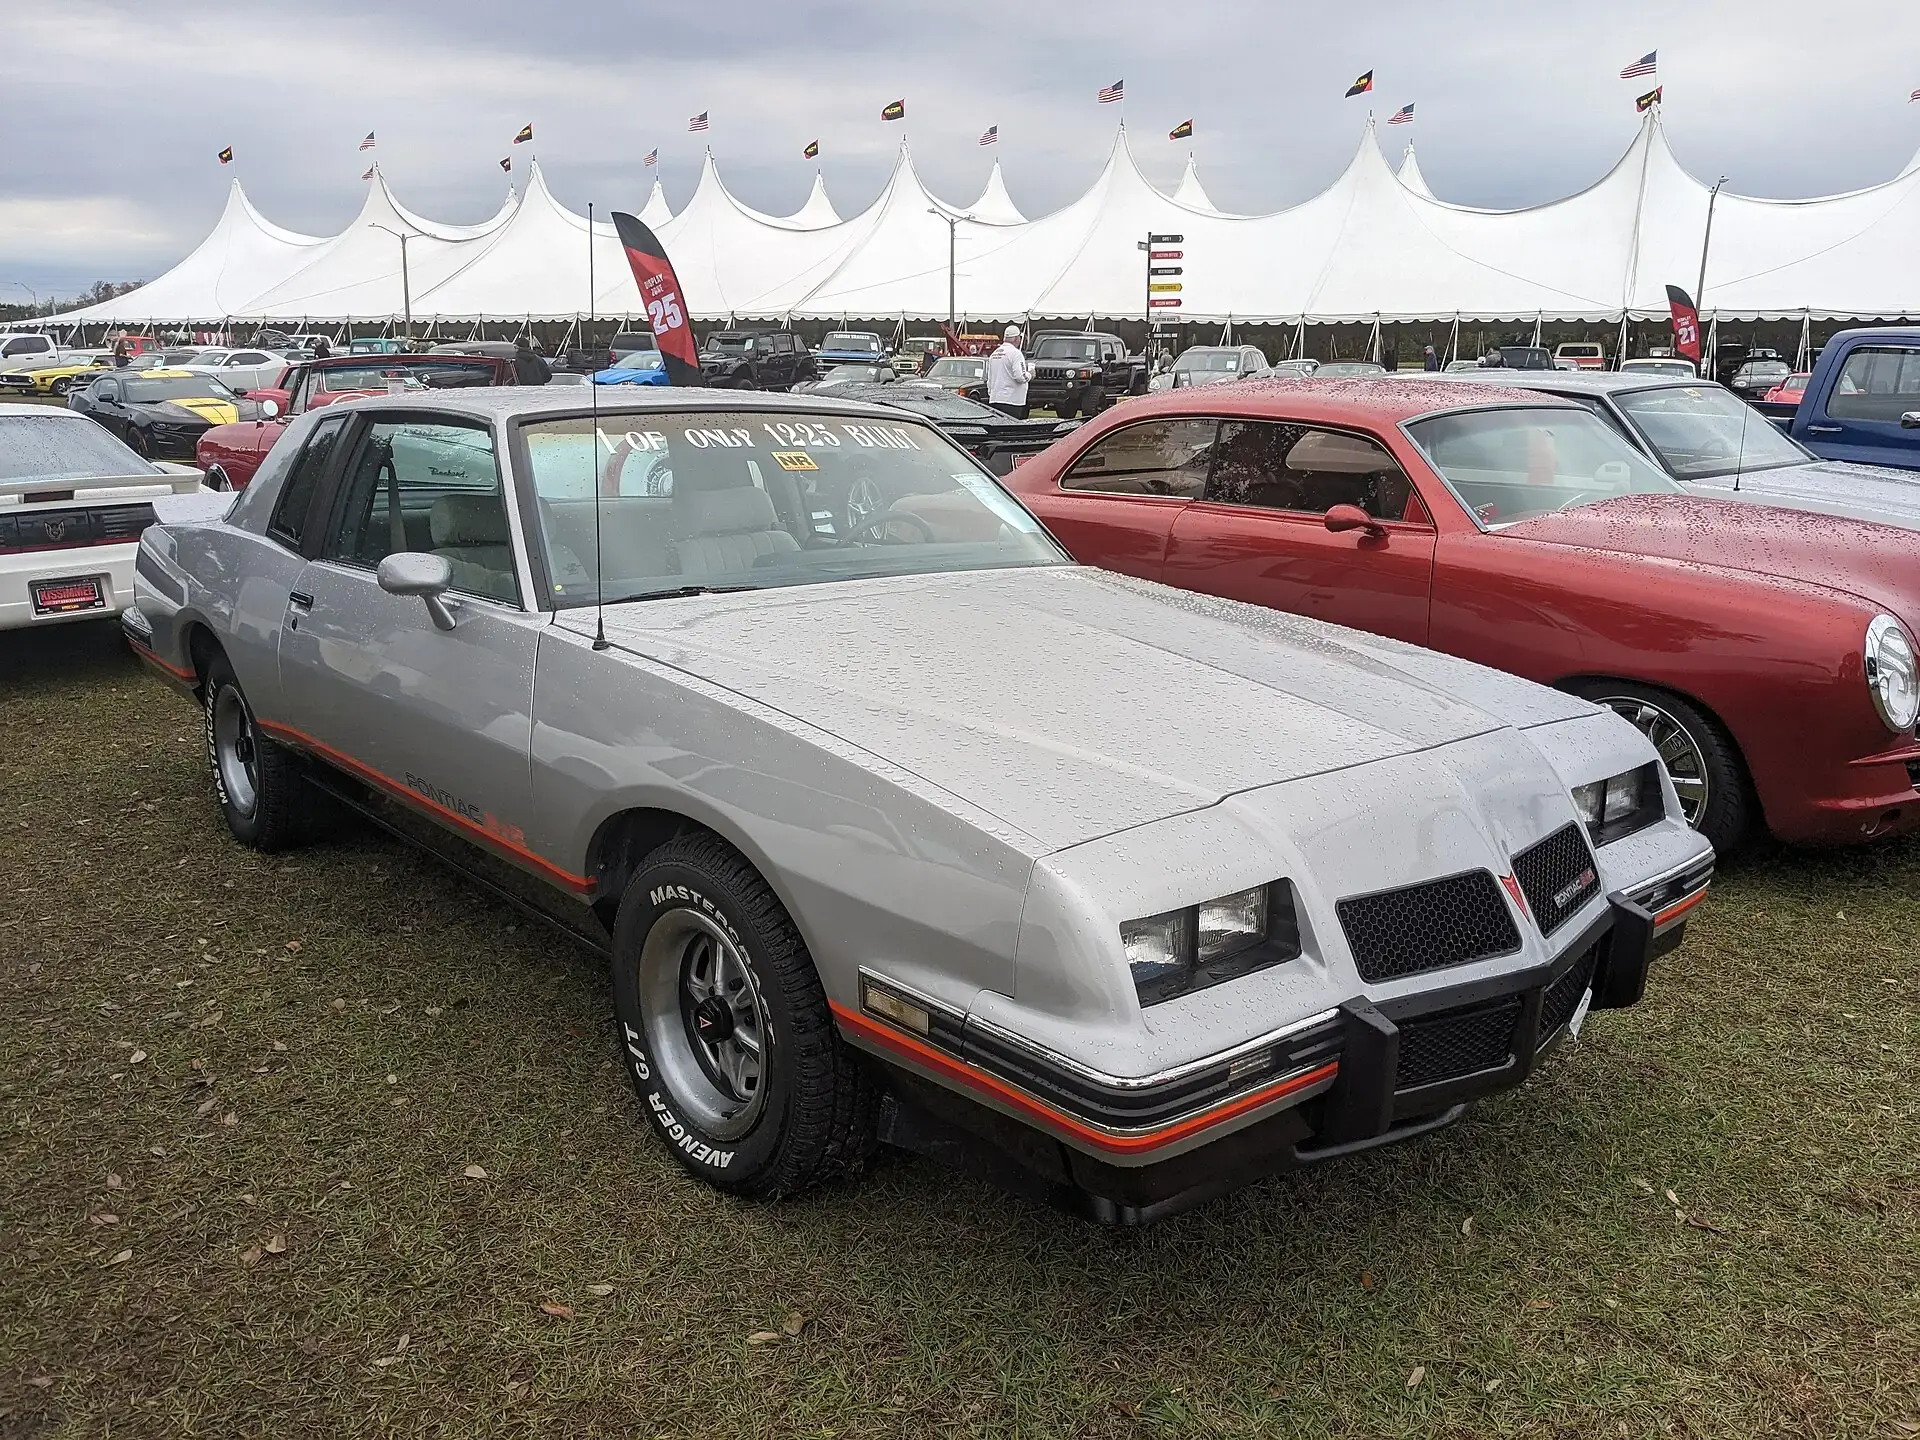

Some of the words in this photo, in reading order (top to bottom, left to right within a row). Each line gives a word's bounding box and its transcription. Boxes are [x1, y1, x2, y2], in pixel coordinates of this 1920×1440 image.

[644, 273, 664, 290] DISPLAY
[648, 292, 683, 336] 25
[1678, 325, 1696, 345] 21
[625, 431, 665, 452] OF
[684, 428, 756, 449] ONLY
[762, 422, 841, 448] 1225
[841, 424, 921, 451] BUILT
[778, 455, 814, 468] NR
[39, 586, 96, 601] KISSIMMEE
[205, 677, 229, 805] MASTERCRAFT
[404, 770, 484, 826] PONTIAC
[1553, 879, 1582, 907] PONTIAC
[623, 1021, 650, 1081] G/T
[649, 1091, 736, 1169] AVENGER
